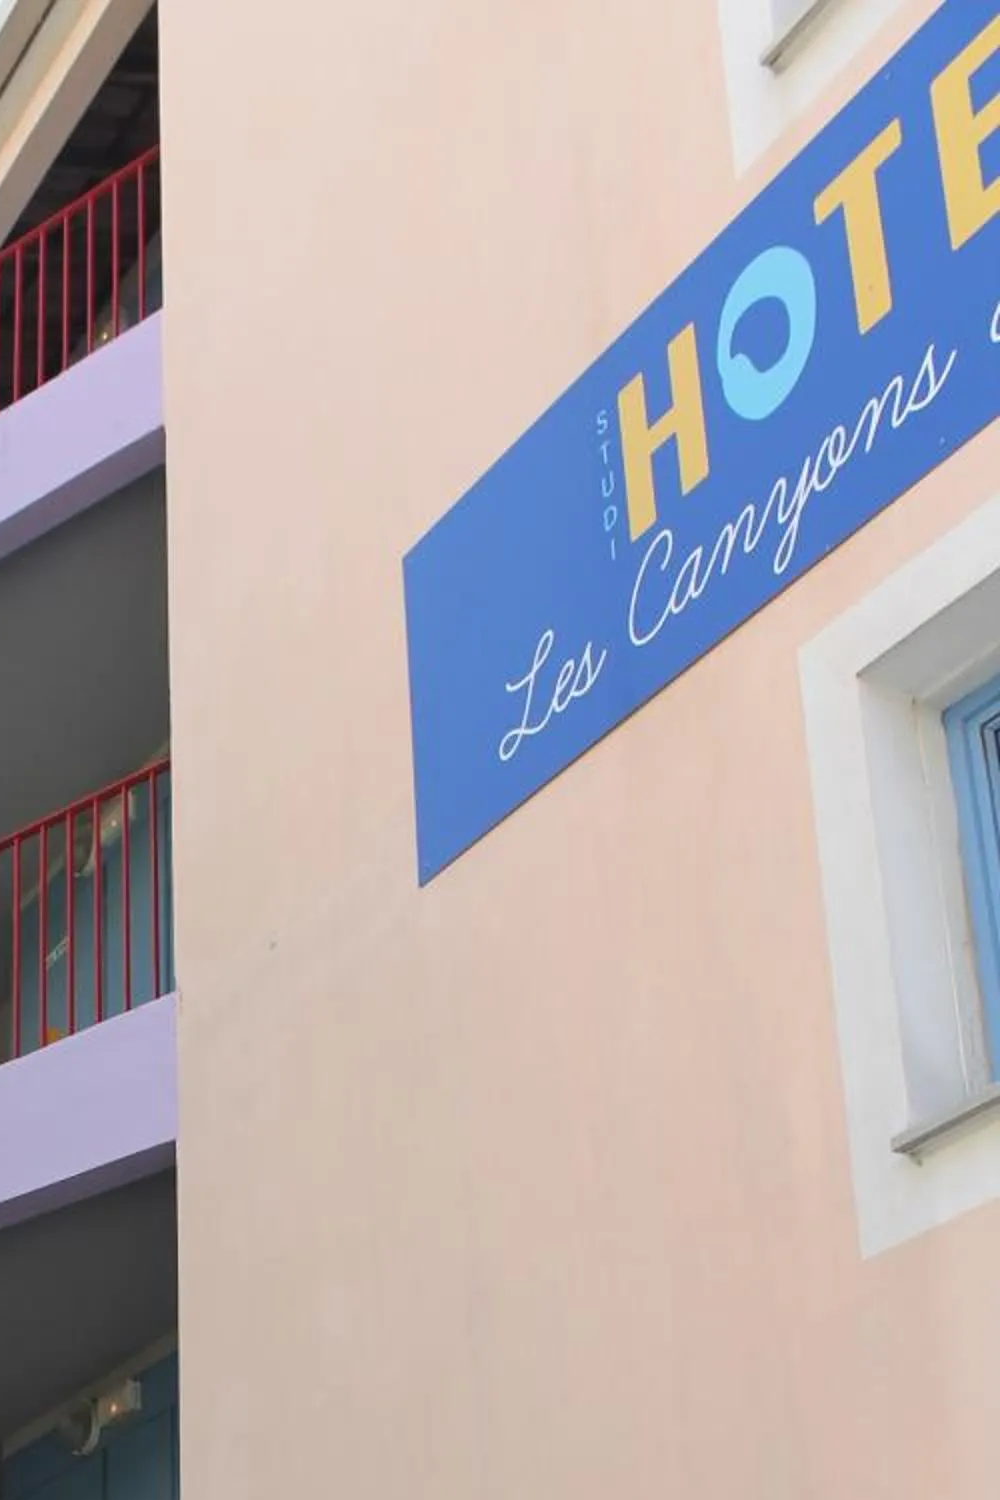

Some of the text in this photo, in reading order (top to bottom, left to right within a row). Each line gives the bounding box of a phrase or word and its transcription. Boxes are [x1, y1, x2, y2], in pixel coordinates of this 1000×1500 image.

[617, 13, 1000, 543] HOTE
[499, 343, 957, 761] Les Canyons
